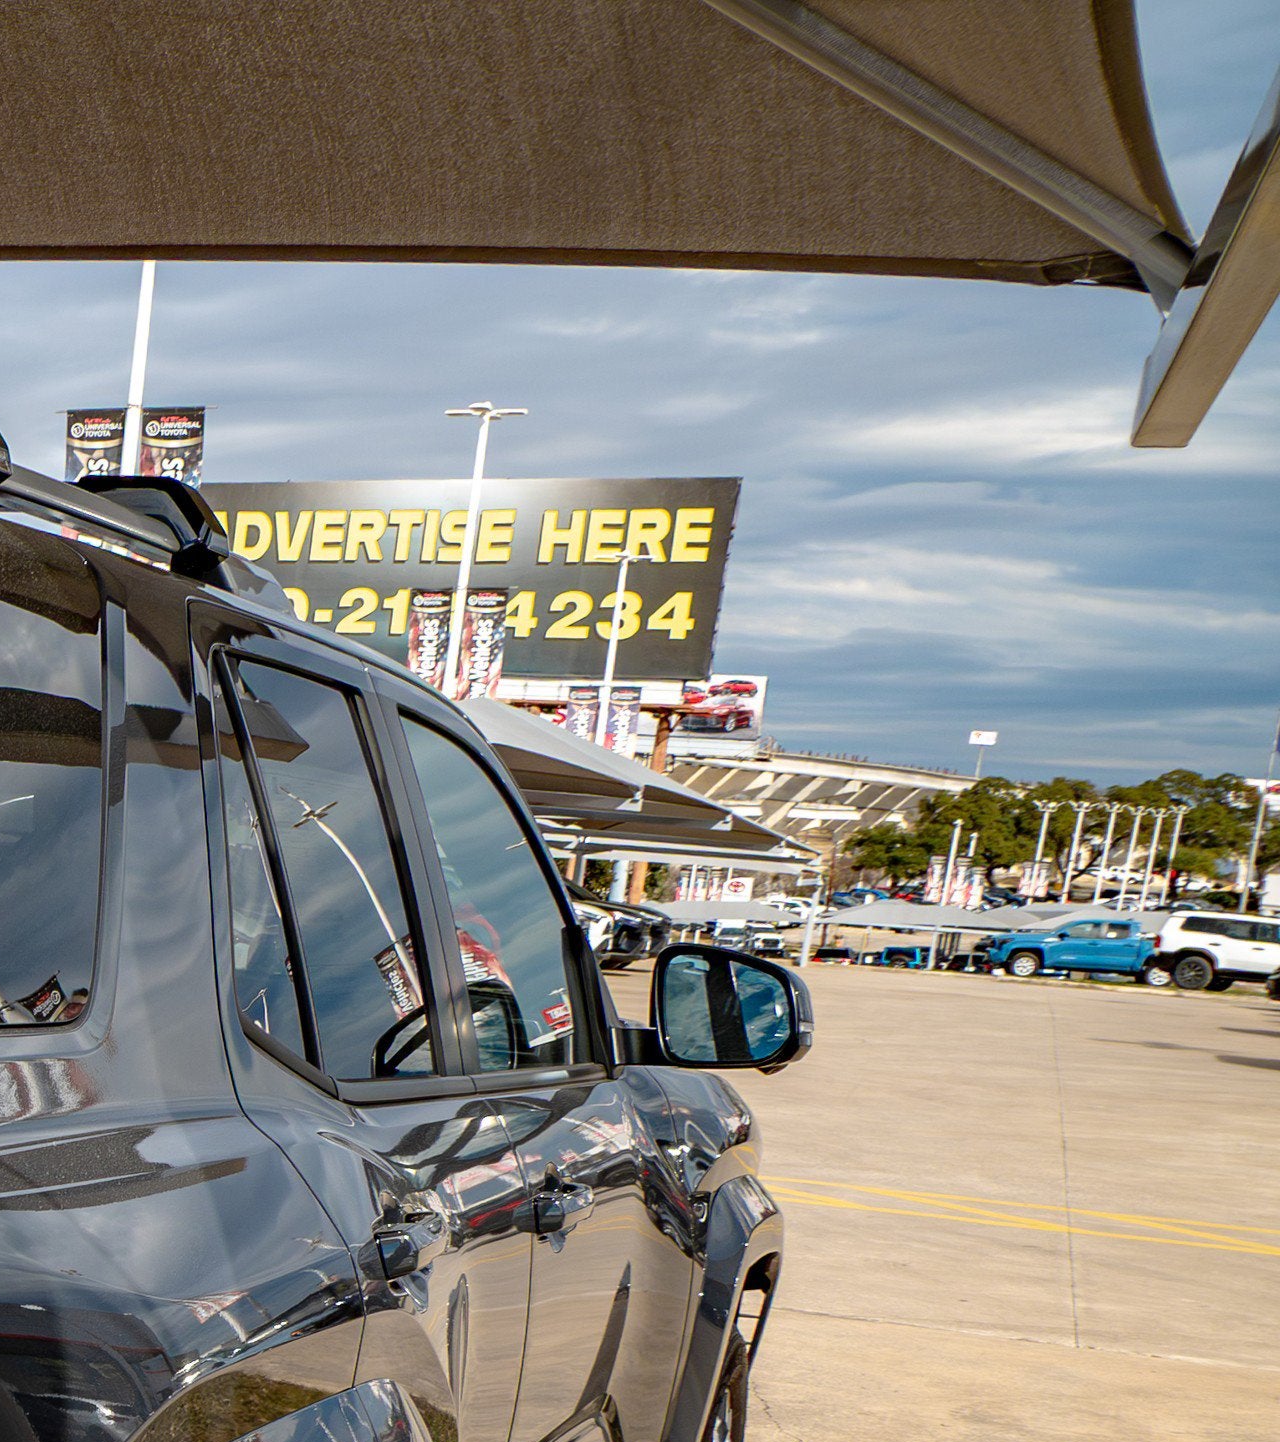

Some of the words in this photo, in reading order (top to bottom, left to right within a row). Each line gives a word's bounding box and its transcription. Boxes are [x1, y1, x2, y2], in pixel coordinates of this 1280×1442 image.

[85, 430, 111, 438] TOYOTA
[160, 429, 187, 437] TOYOTA
[537, 507, 716, 563] HERE
